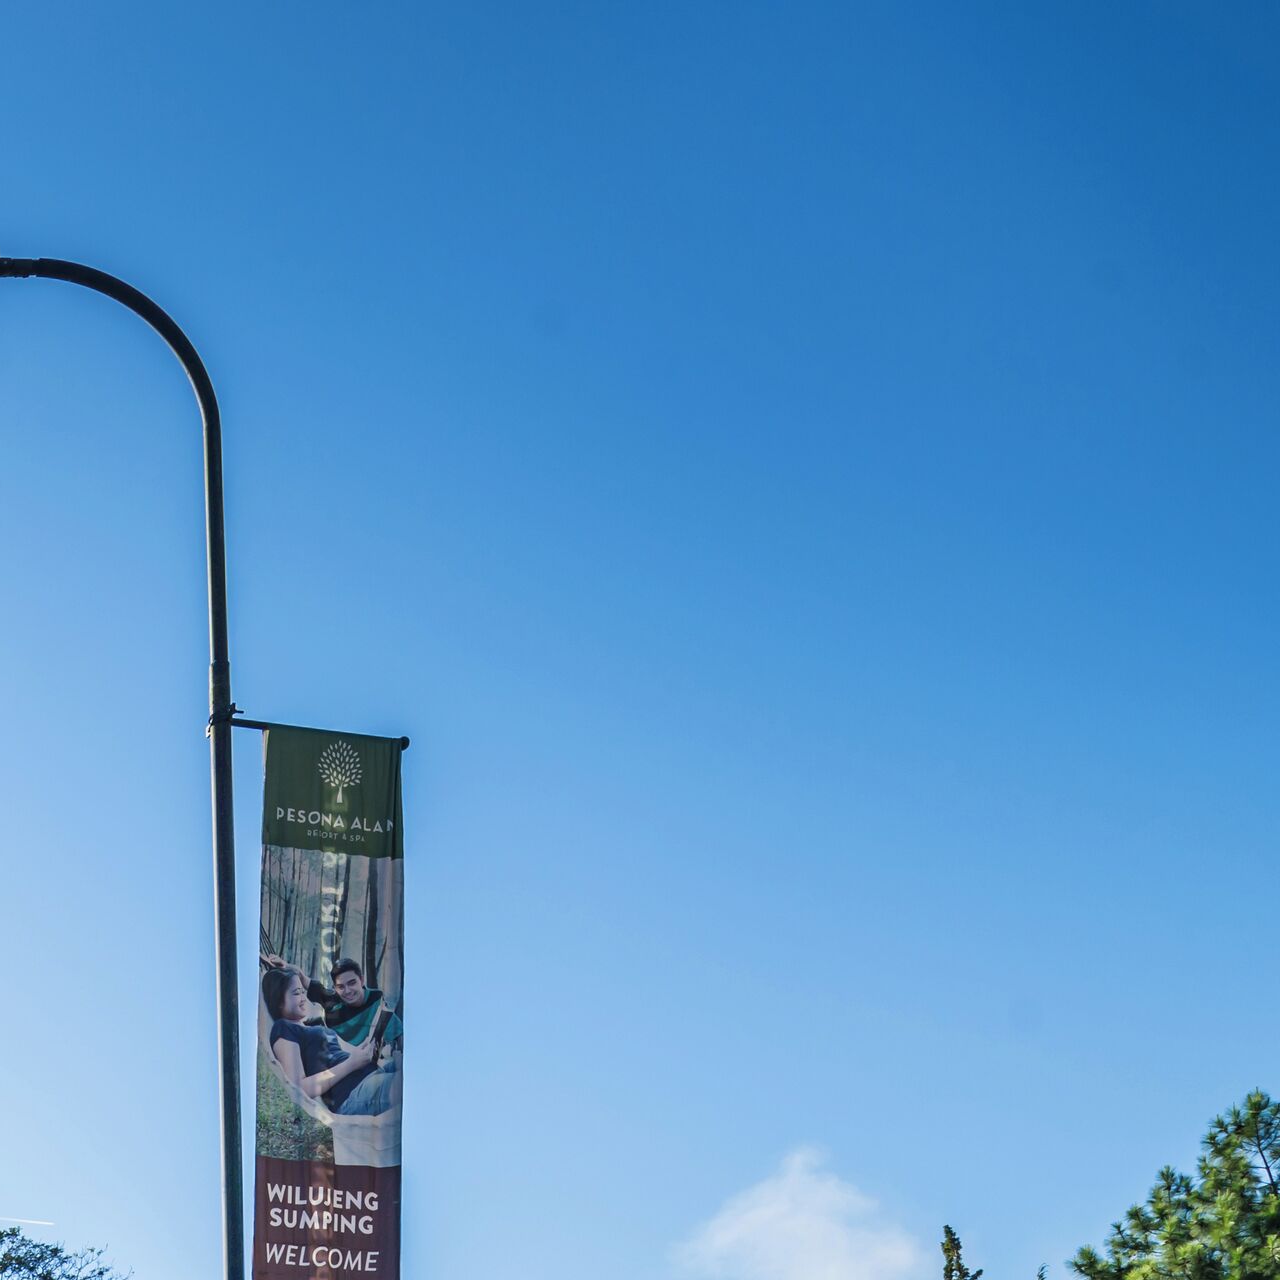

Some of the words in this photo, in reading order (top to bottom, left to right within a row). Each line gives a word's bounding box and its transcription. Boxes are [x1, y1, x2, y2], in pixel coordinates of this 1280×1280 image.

[276, 807, 345, 828] PESONA
[266, 1182, 379, 1211] WILUJENG
[269, 1207, 374, 1235] SUMPING
[265, 1242, 380, 1272] WELCOME
